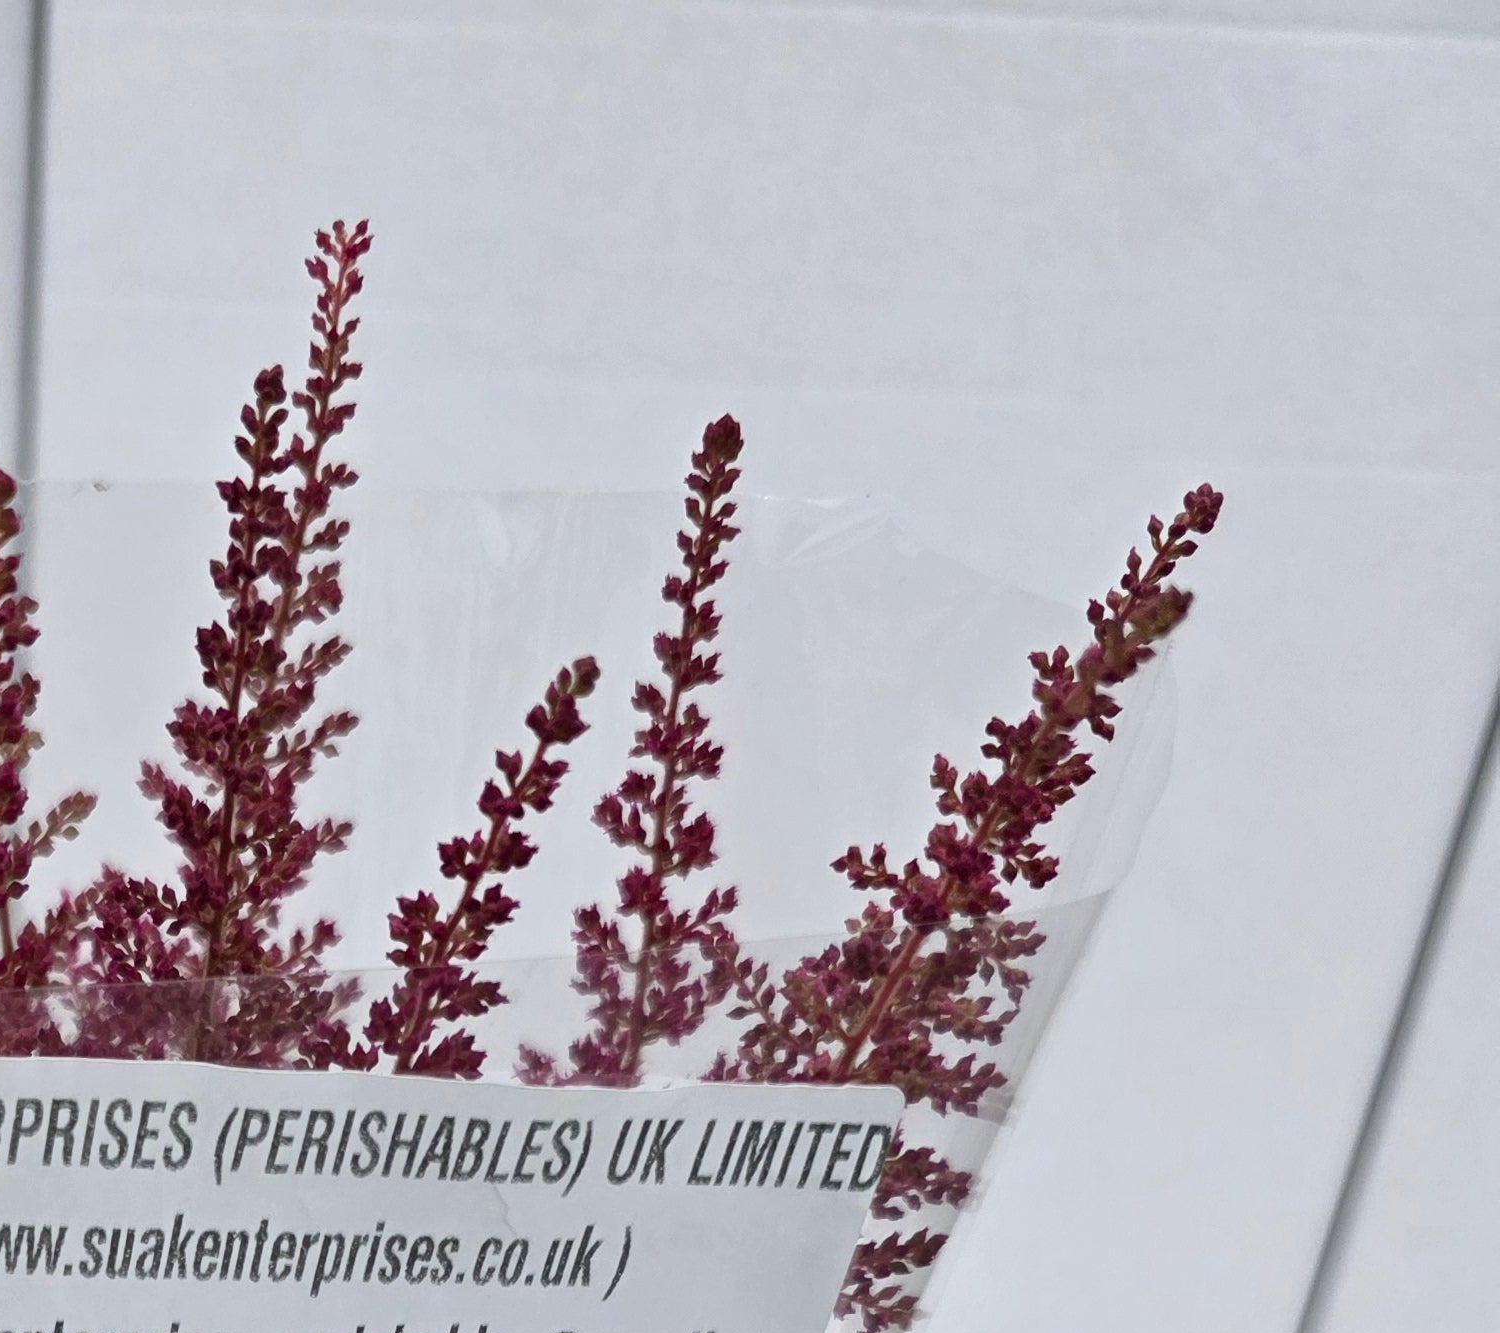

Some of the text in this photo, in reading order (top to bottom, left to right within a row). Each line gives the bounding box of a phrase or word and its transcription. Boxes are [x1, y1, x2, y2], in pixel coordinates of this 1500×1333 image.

[213, 1107, 594, 1198] (PERISHABLES)
[606, 1119, 685, 1186] UK
[686, 1119, 893, 1193] LIMITED
